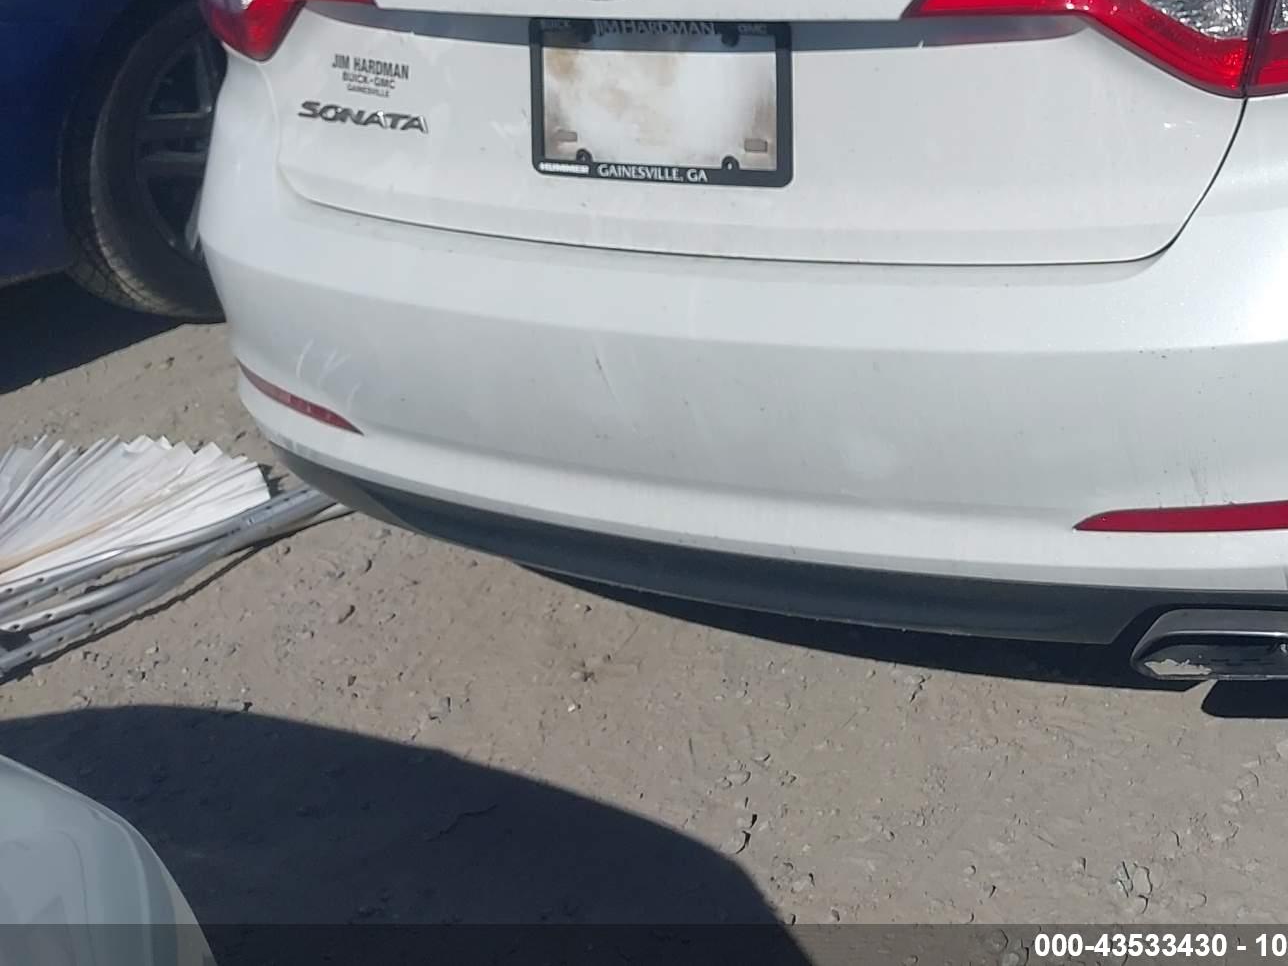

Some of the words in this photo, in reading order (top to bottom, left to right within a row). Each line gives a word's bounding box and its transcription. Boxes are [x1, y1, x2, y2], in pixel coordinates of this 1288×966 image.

[593, 20, 617, 36] JIM
[620, 20, 716, 35] HARDMAN
[332, 53, 350, 69] JIM
[353, 57, 409, 79] HARDMAN
[297, 100, 428, 134] SONATA
[597, 164, 684, 182] GAINESVILLE,
[686, 168, 708, 182] GA
